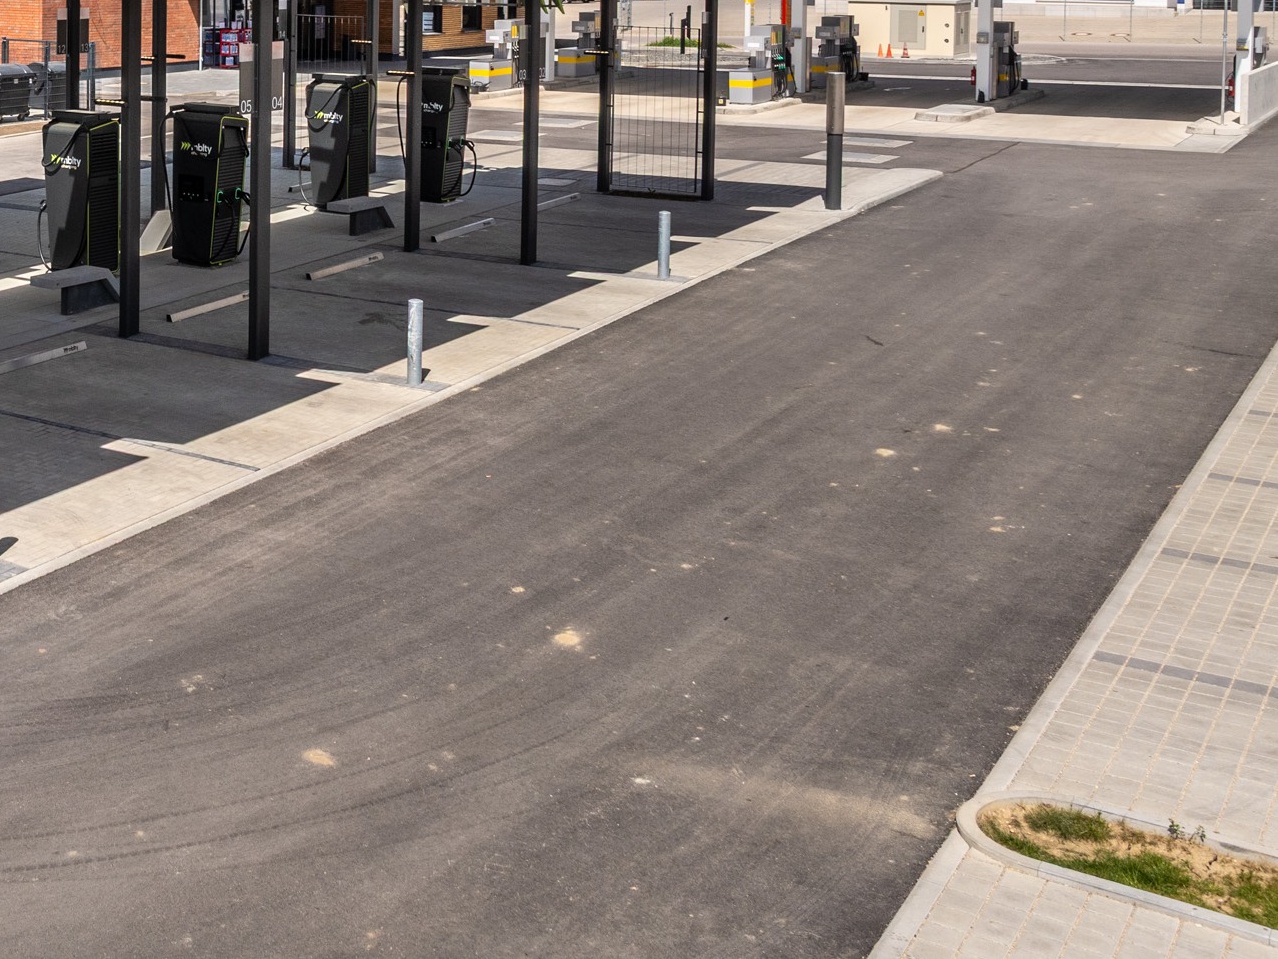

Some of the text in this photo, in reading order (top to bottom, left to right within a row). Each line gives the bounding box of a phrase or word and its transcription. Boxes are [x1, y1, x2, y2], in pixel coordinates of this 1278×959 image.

[58, 44, 66, 53] 12
[81, 43, 89, 52] 13
[519, 69, 527, 80] 03
[241, 100, 252, 113] 05
[272, 97, 283, 109] 04
